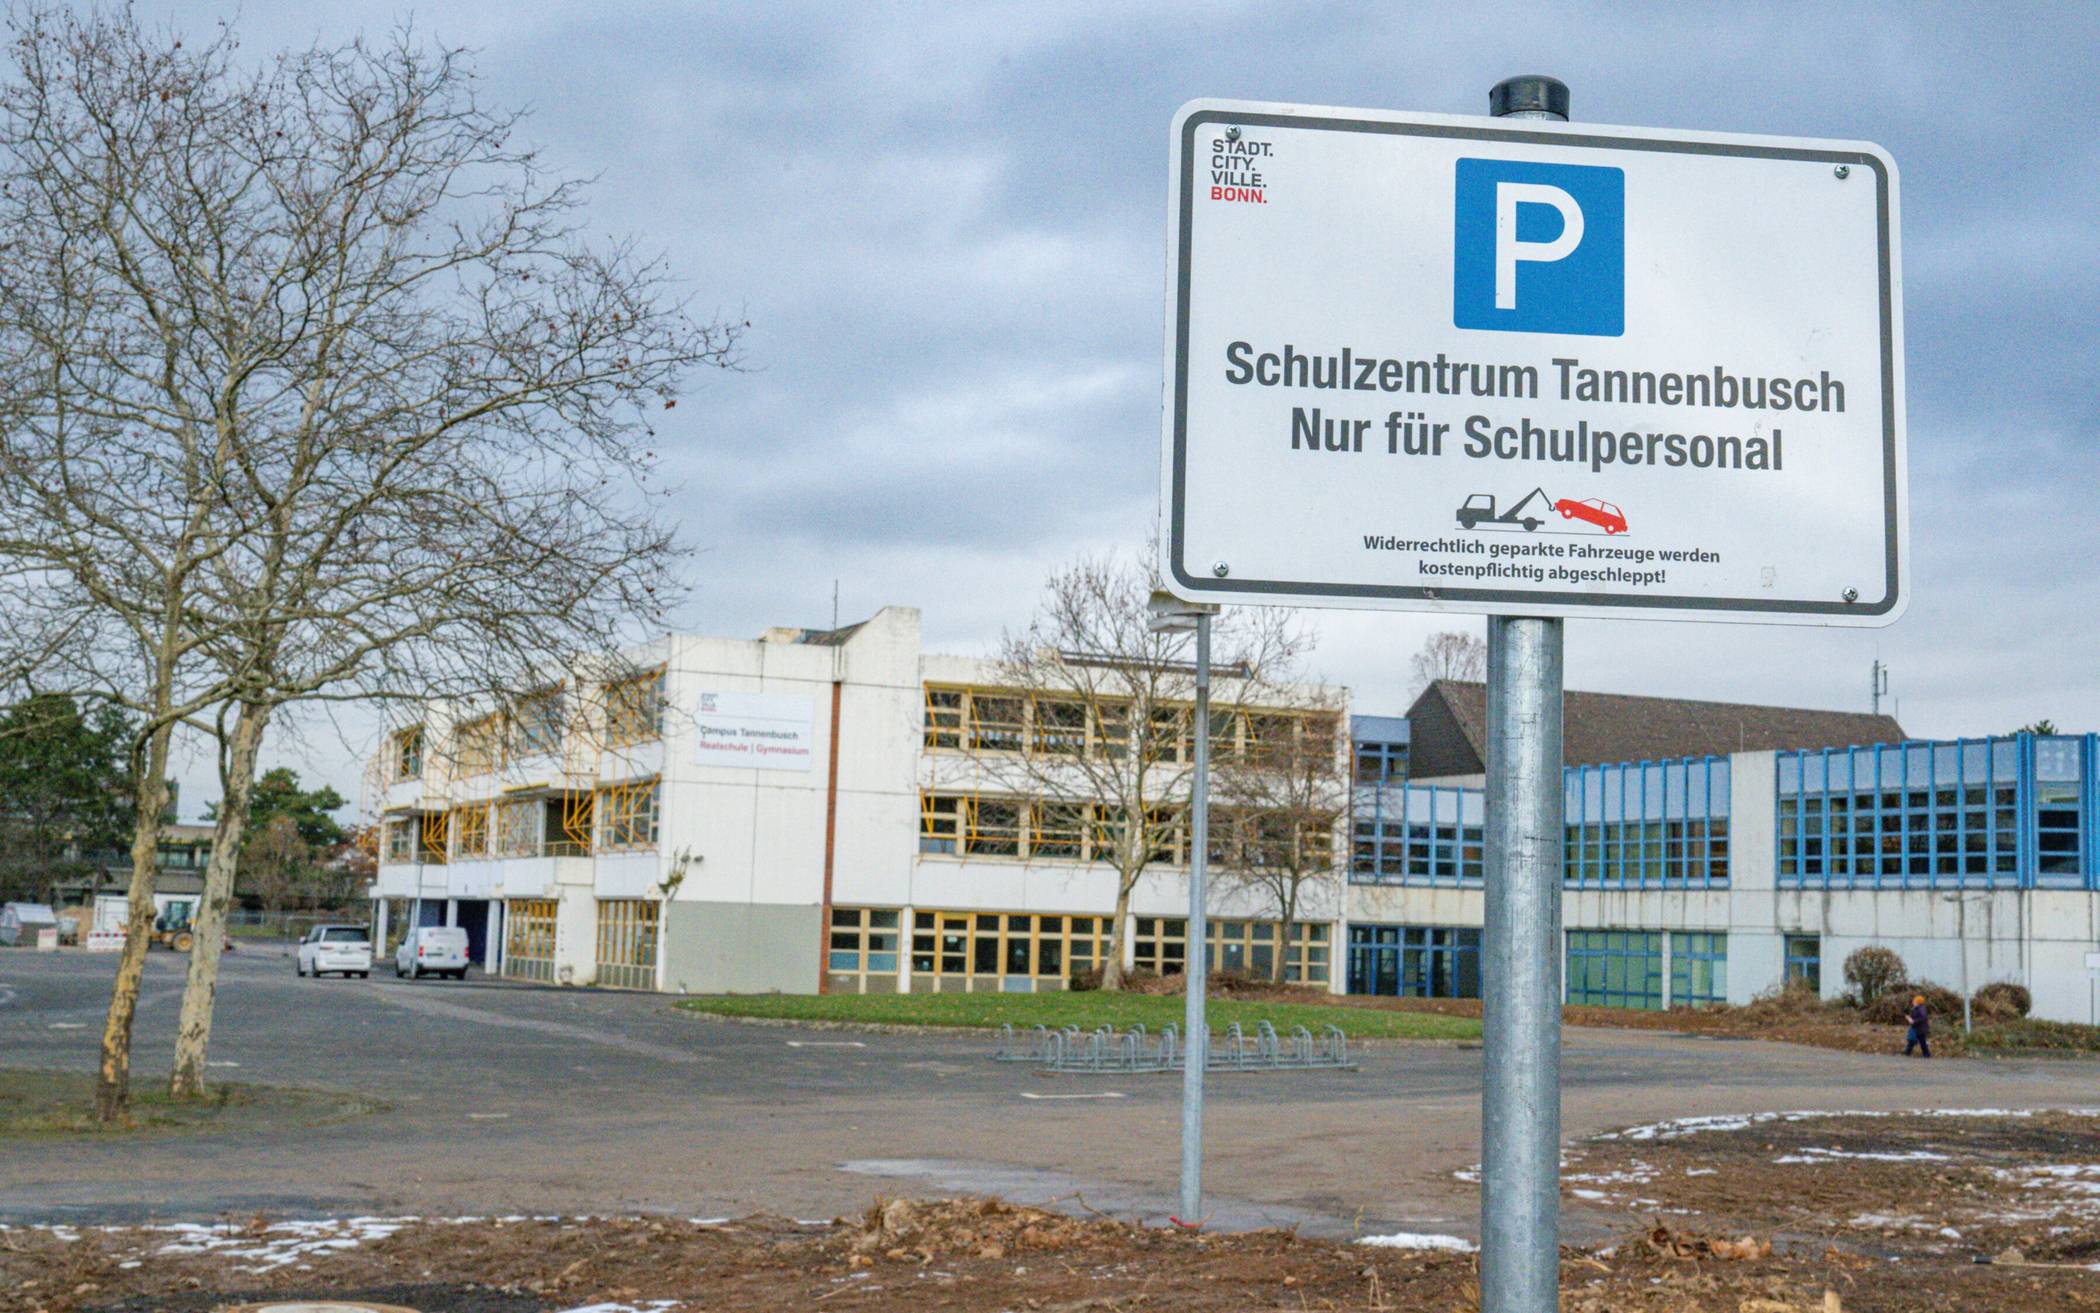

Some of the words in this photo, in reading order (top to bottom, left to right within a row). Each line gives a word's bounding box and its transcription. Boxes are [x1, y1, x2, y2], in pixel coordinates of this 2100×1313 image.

[1212, 139, 1274, 157] STADT.
[1212, 154, 1256, 171] CITY.
[1211, 170, 1267, 188] VILLE.
[1211, 186, 1268, 204] BONN.
[1495, 182, 1585, 310] P
[1226, 342, 1538, 399] Schulzentrum
[1552, 358, 1846, 413] Tannenbusch
[1291, 408, 1372, 453] Nur
[1385, 412, 1450, 456] für
[1463, 416, 1783, 473] Schulpersonal
[1363, 536, 1485, 554] Widerrechtlich
[1489, 541, 1565, 559] geparkte
[1568, 544, 1655, 563] Fahrzeuge
[1659, 547, 1720, 563] werden
[1419, 560, 1544, 583] kostenpflichtig
[1548, 565, 1666, 586] abgeschleppt!
[741, 728, 799, 740] Tannenbusch
[700, 740, 749, 752] Realschule
[756, 744, 809, 756] Gymnasium
